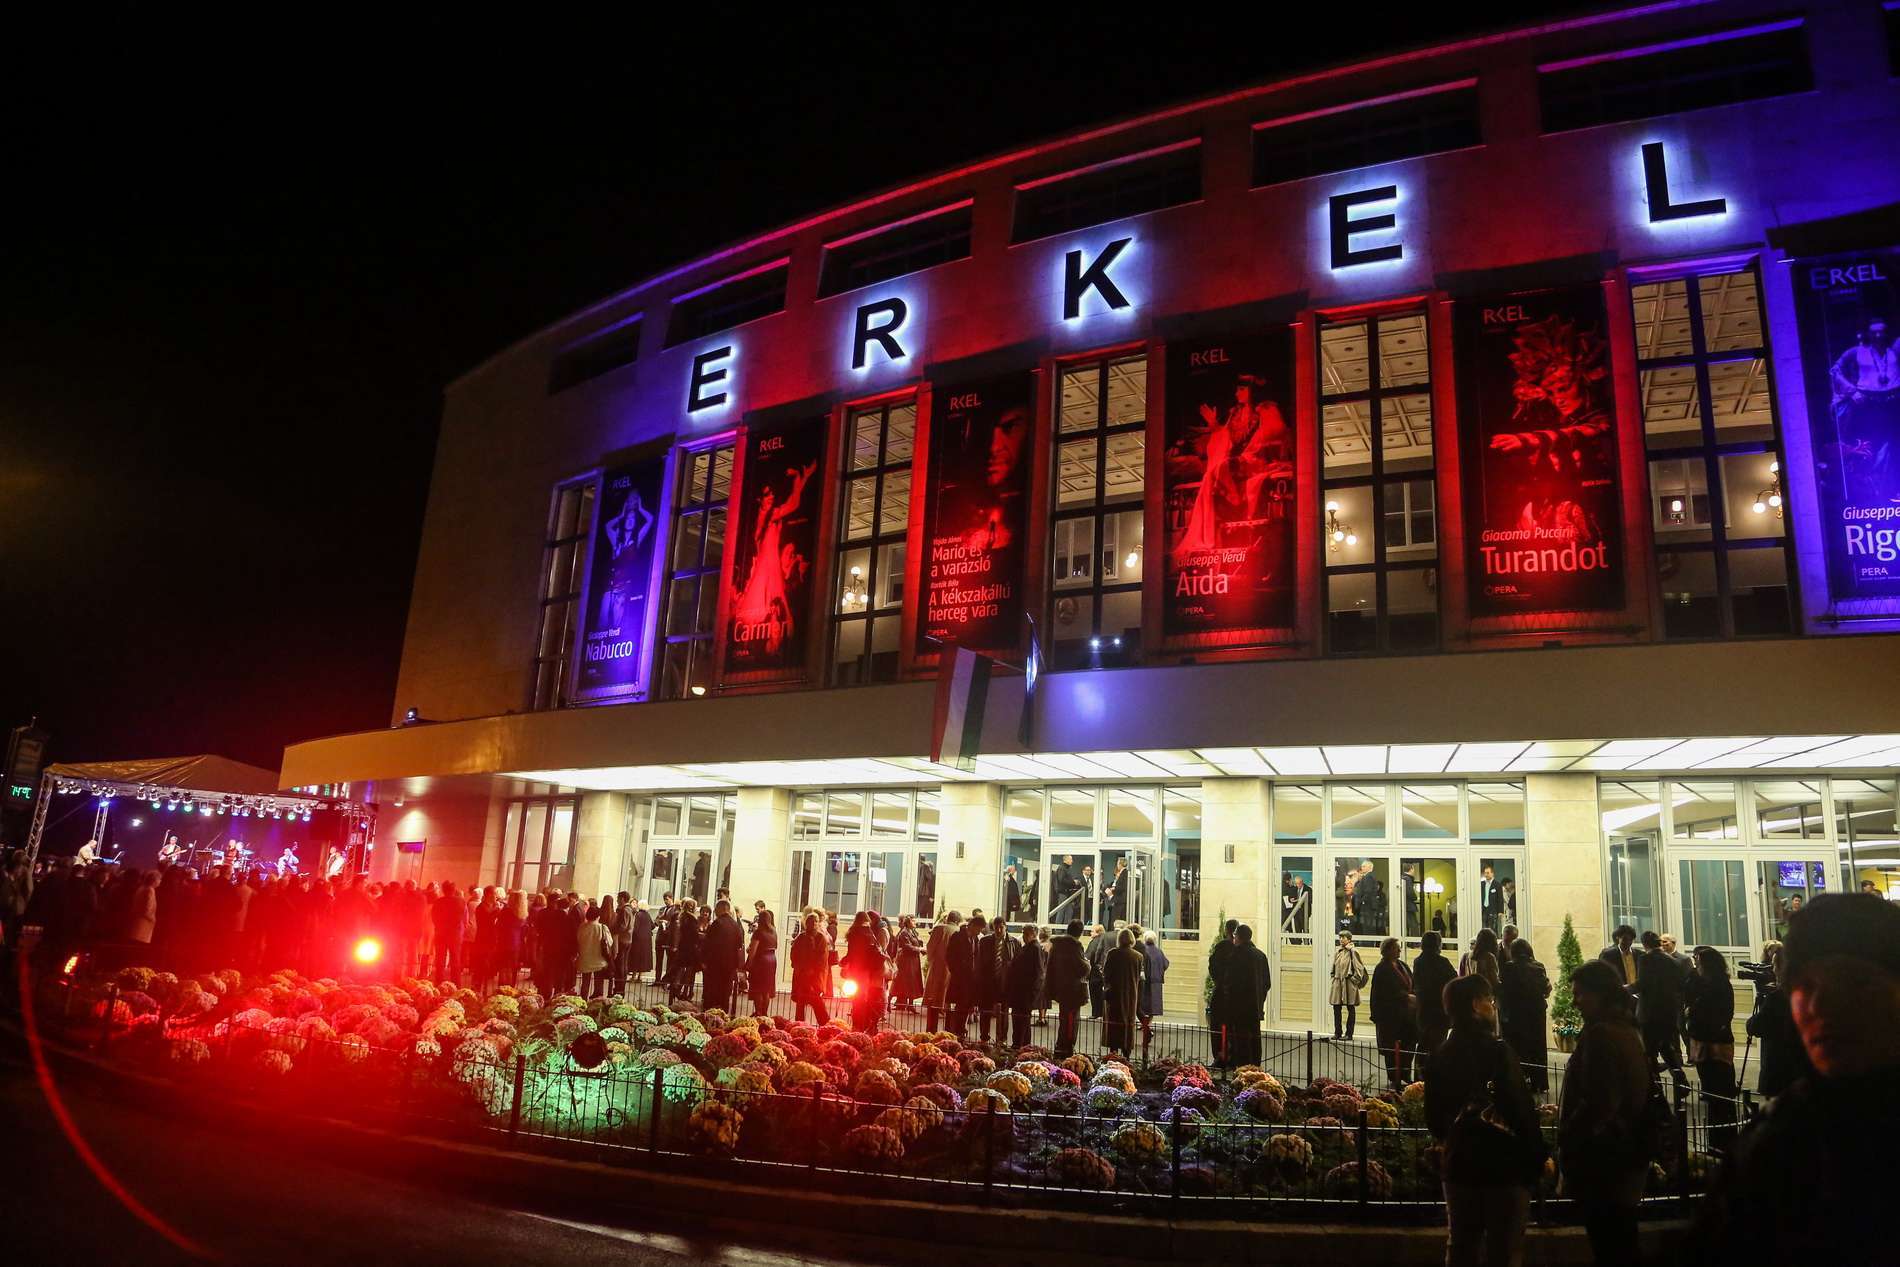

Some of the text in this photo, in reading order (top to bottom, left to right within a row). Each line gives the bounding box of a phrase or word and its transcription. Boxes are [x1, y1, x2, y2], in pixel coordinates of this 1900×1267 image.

[1482, 526, 1574, 543] Giacomo Puccini
[932, 544, 966, 562] Mario
[1222, 550, 1246, 564] Verdi
[1480, 541, 1609, 575] Turandot
[930, 553, 991, 577] a varázsló
[1175, 567, 1229, 598] Aida
[929, 591, 937, 606] A
[928, 601, 998, 623] herceg vára
[585, 640, 633, 661] Nabucco
